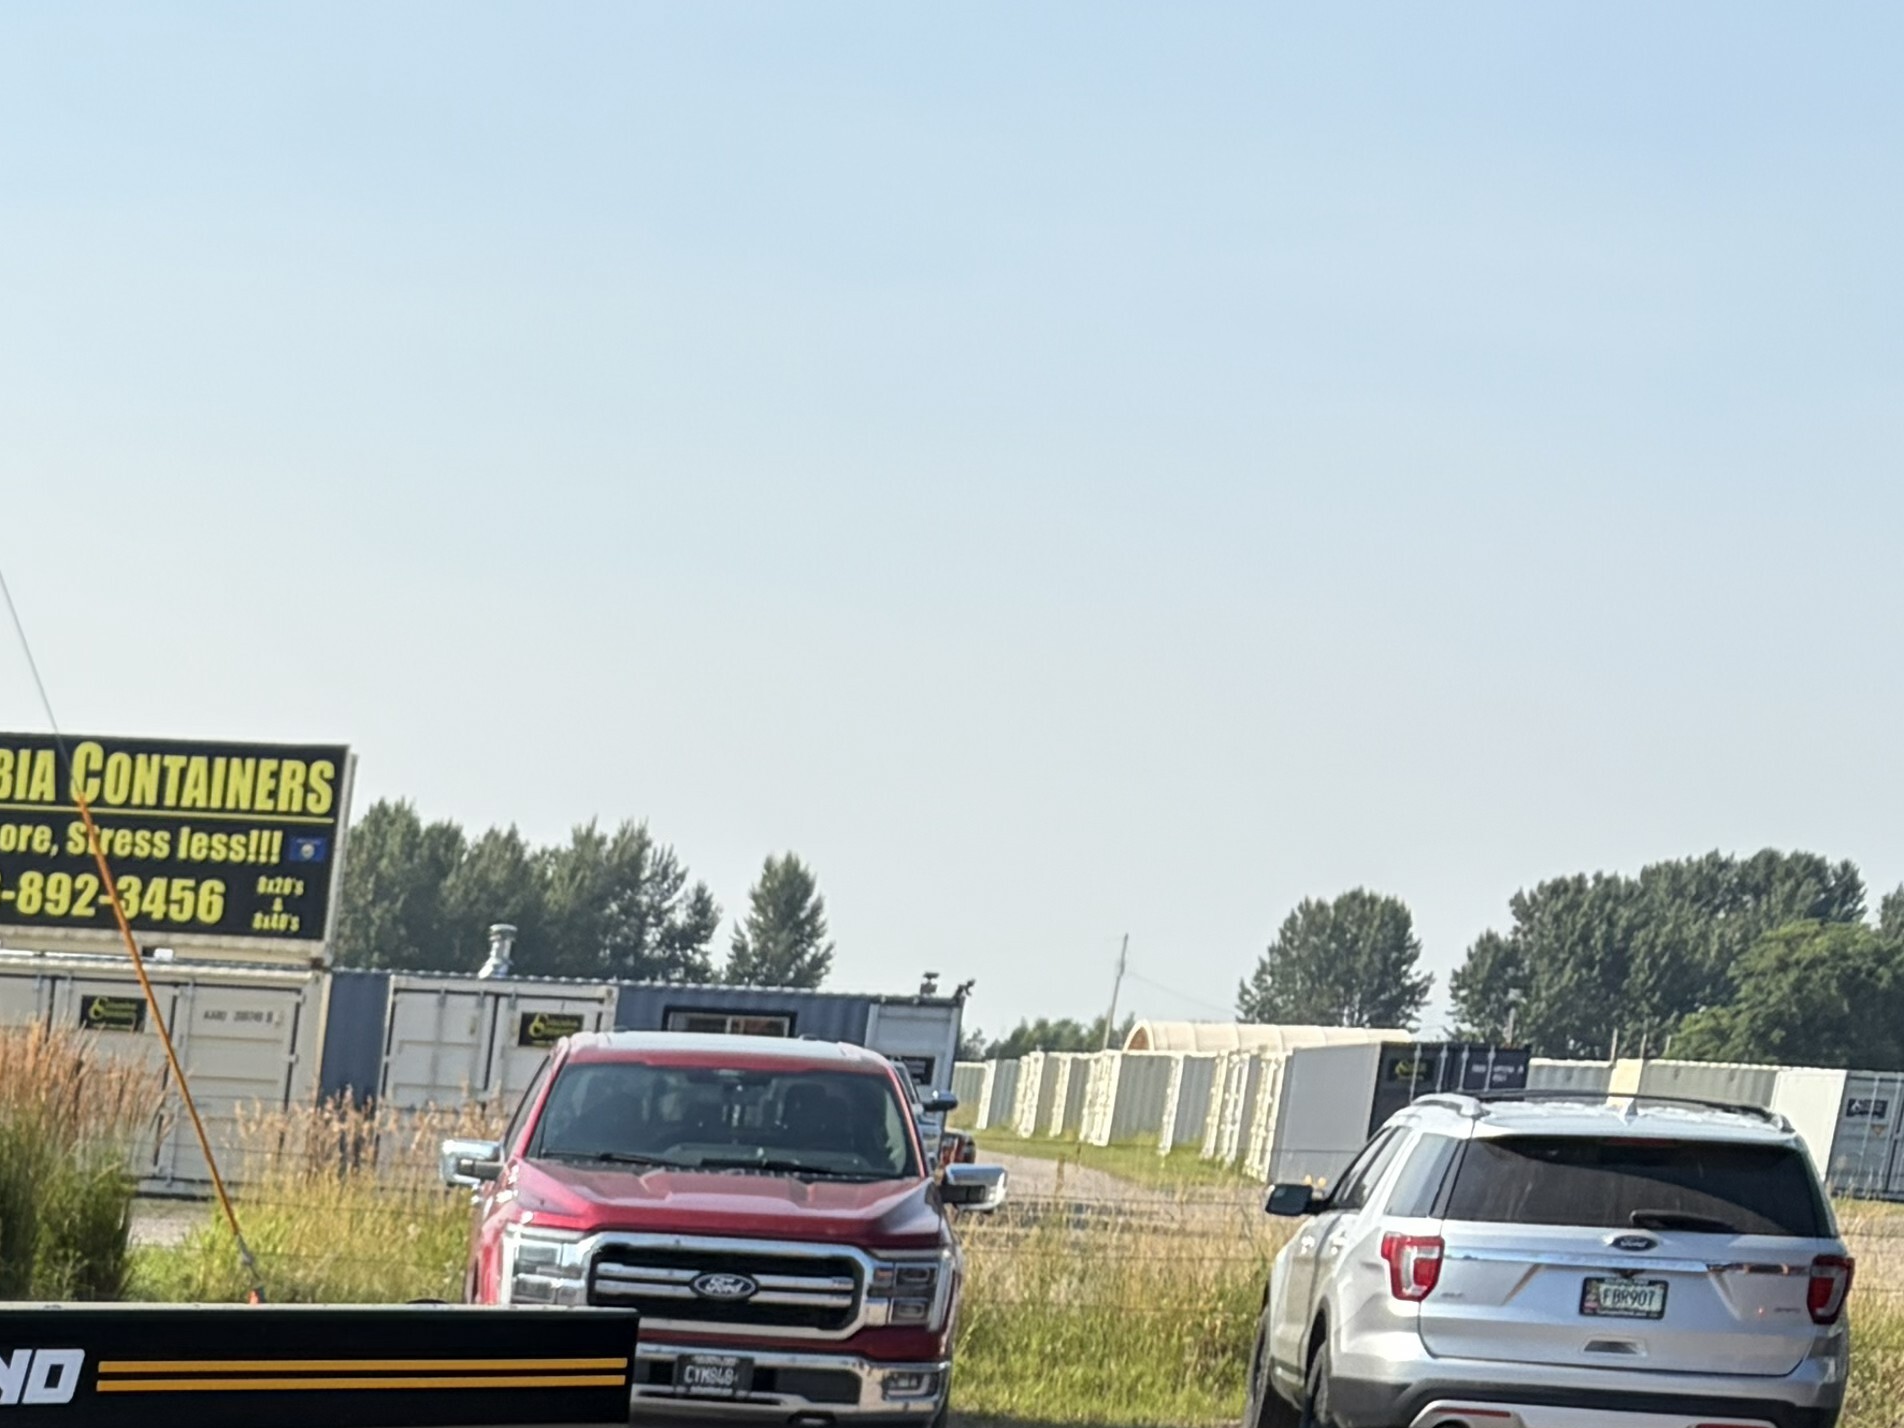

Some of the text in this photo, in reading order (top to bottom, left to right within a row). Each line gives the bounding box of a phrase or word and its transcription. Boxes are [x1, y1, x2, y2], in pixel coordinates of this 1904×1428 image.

[70, 741, 335, 815] CONTAINERS
[176, 826, 283, 864] less!!!
[704, 1276, 744, 1294] Ford
